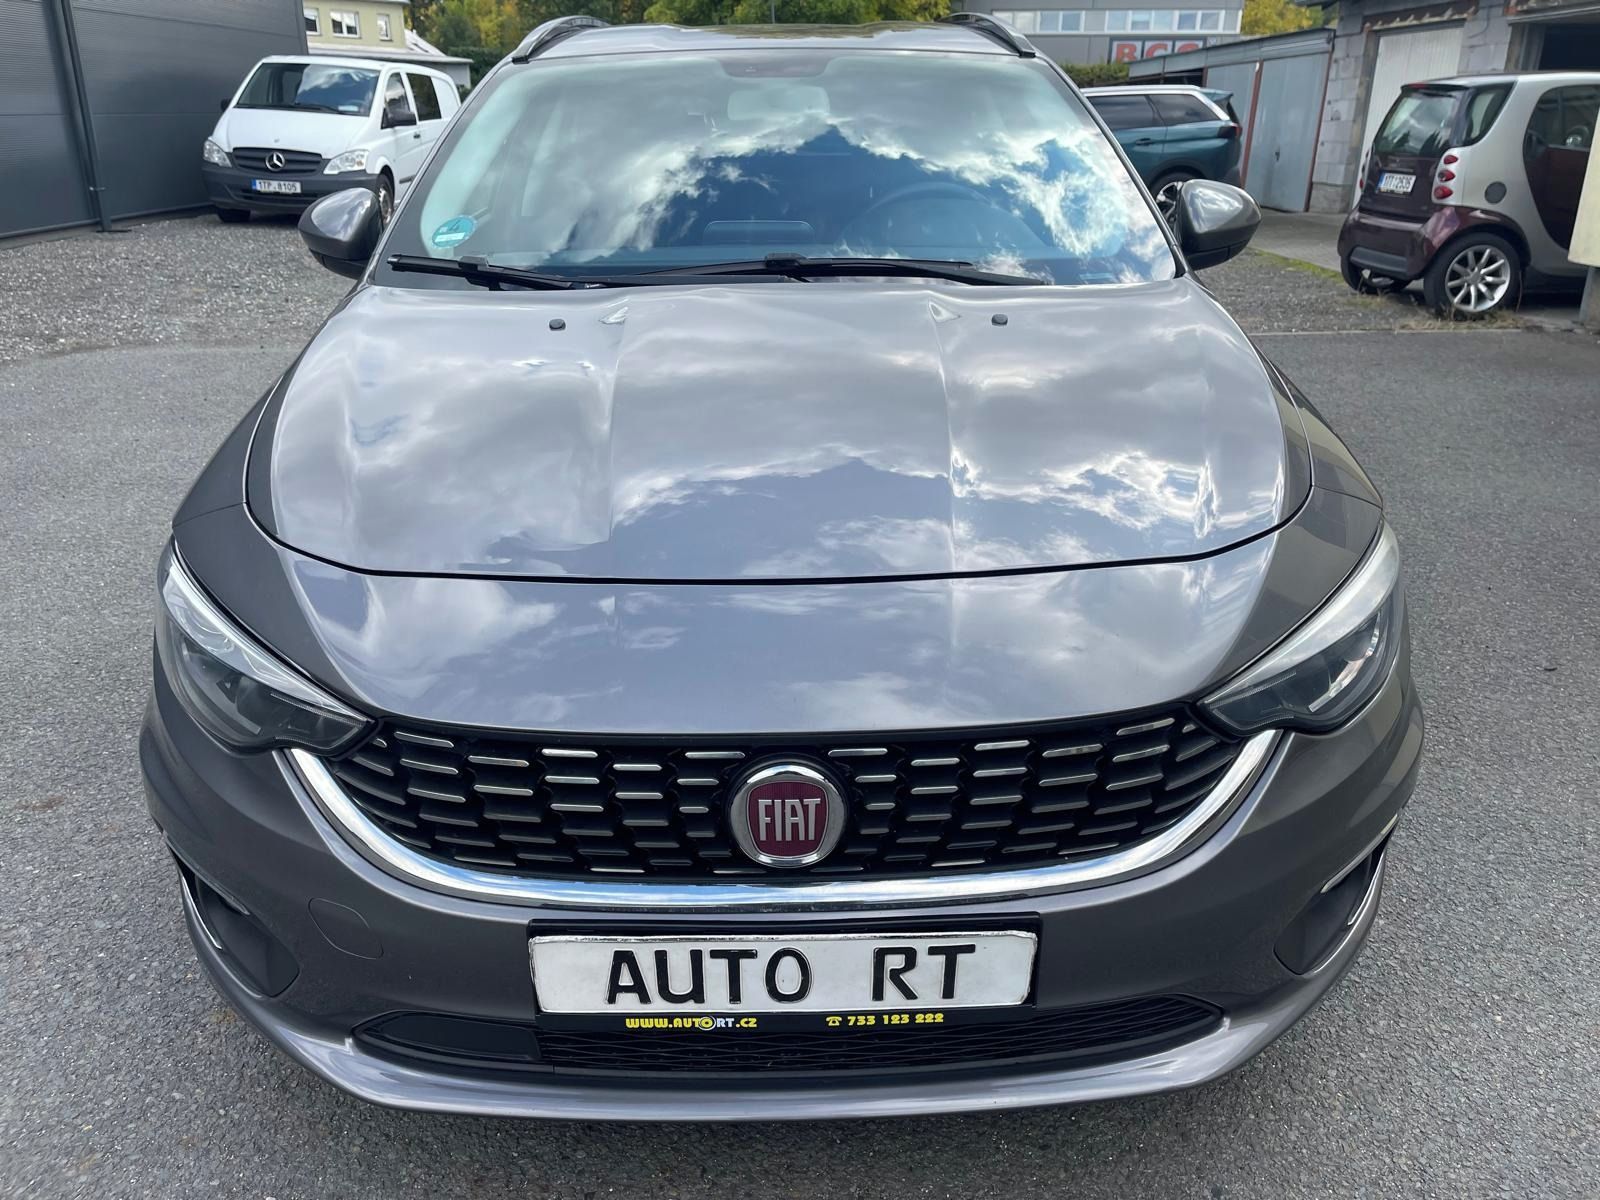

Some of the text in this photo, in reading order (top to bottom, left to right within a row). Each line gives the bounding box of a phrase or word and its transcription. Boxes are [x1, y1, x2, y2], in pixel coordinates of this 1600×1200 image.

[758, 798, 821, 842] FIAT
[605, 943, 977, 1006] AUTO RT
[847, 1012, 944, 1026] 733 123 222
